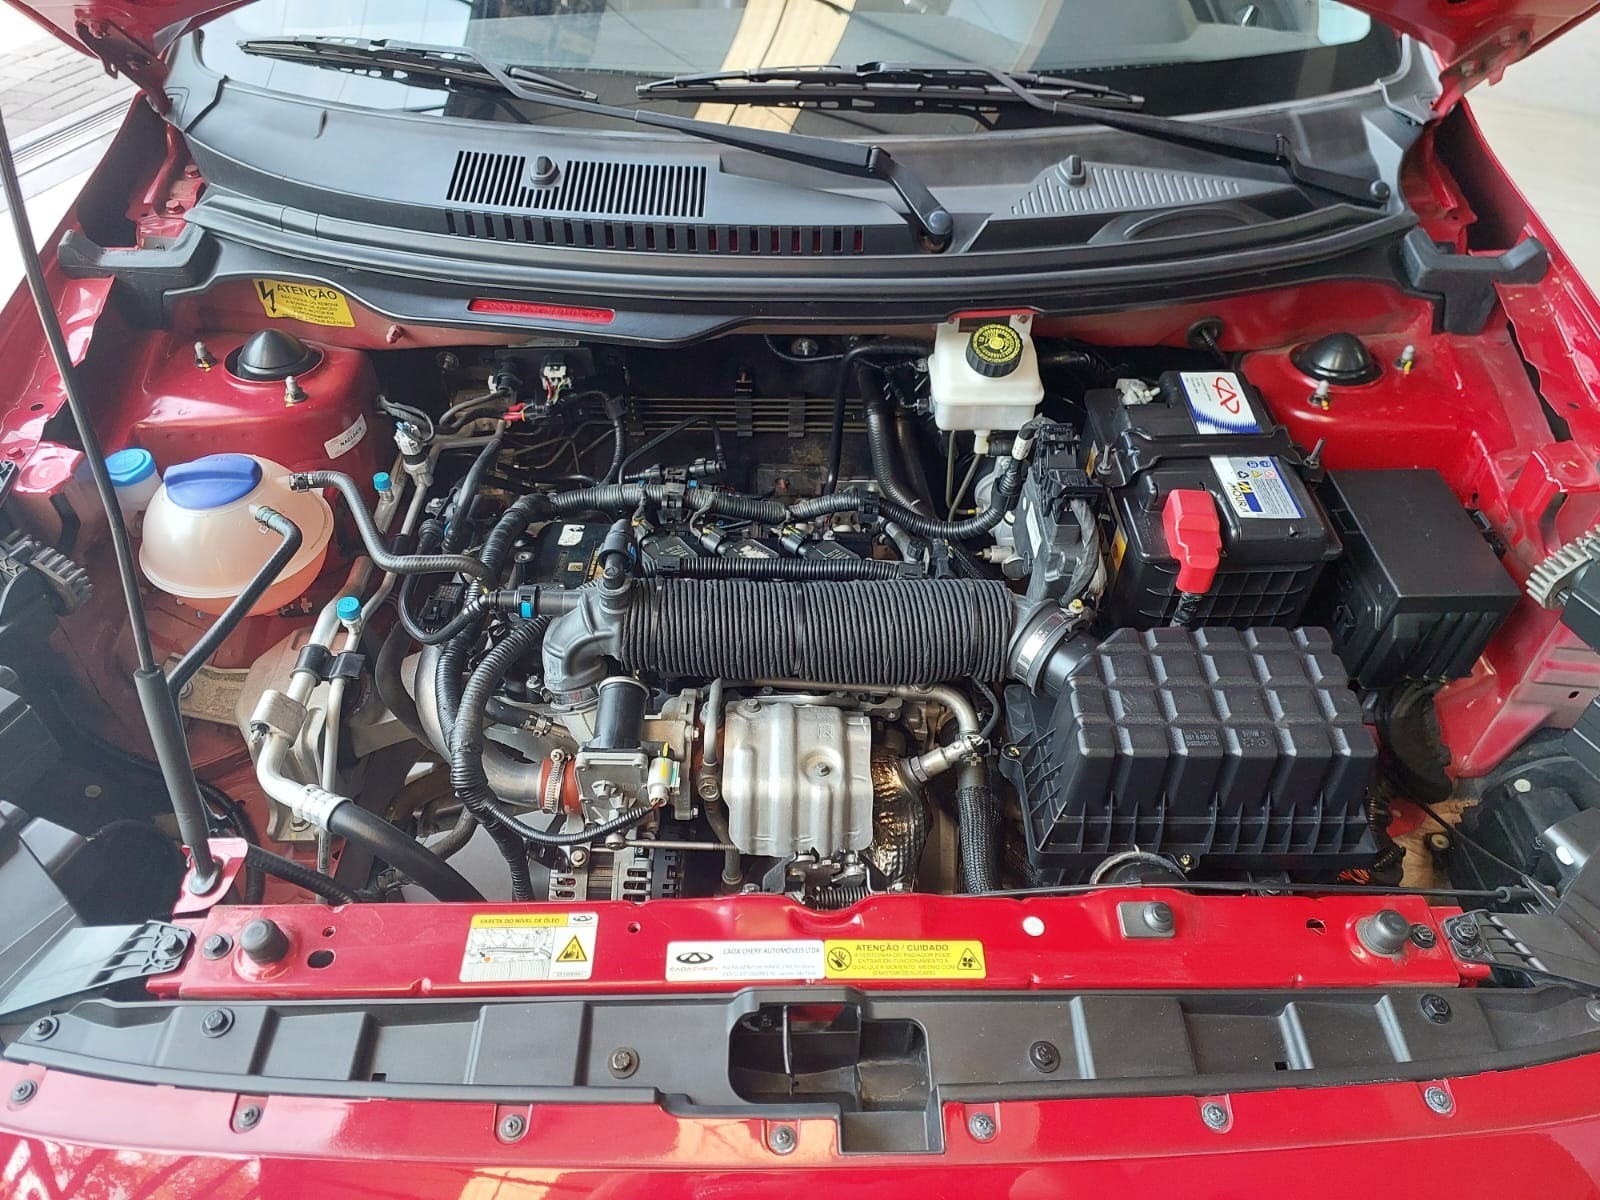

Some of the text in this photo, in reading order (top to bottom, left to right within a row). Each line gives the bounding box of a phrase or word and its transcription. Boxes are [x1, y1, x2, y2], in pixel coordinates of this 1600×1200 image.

[277, 283, 337, 300] ATENÇÃO
[1227, 482, 1250, 513] MOURA
[741, 947, 762, 955] CHERY
[763, 946, 804, 954] AUTOMÓVEIS
[855, 943, 900, 953] ATENÇÃO
[907, 944, 949, 952] CUIDADO
